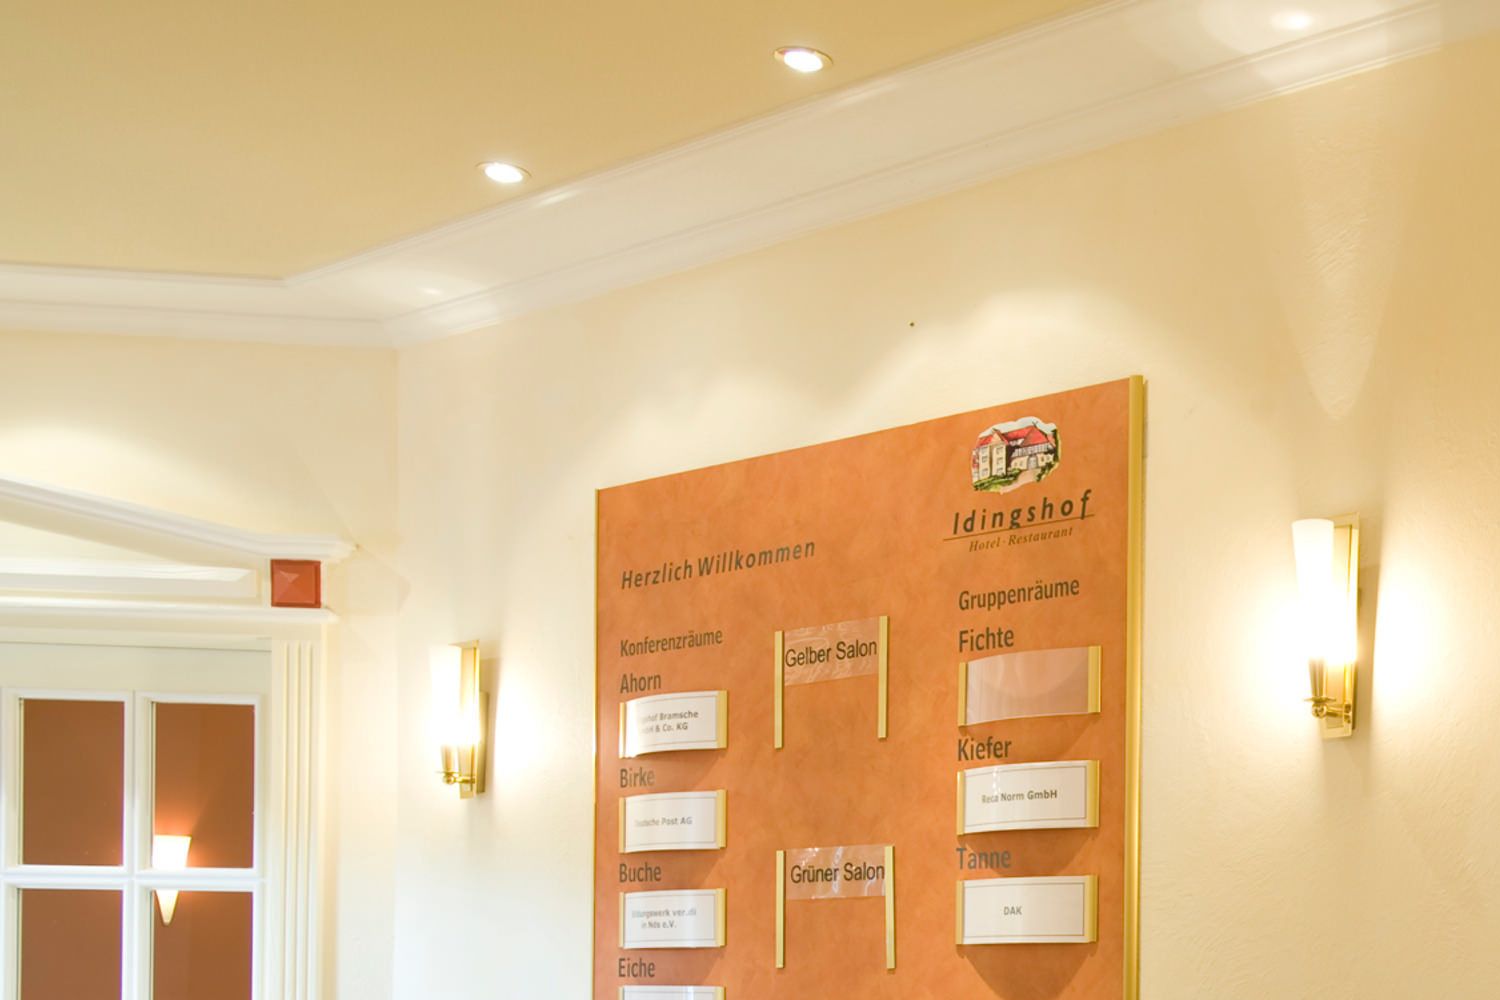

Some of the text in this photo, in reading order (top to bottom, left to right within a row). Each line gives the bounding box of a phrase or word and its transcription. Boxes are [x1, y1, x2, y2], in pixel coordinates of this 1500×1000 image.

[953, 489, 1092, 534] Idingshof
[969, 527, 1074, 552] Hotel Restaurant
[621, 541, 816, 590] Herzlich Willkommen
[959, 579, 1080, 611] Gruppenräume
[620, 630, 723, 657] Konferenzräume
[959, 627, 1014, 652] Fichte
[785, 639, 877, 667] Gelber Salon
[620, 672, 661, 694] Ahorn
[676, 721, 688, 731] KG
[957, 736, 1012, 762] Kiefer
[620, 766, 655, 788] Birke
[1000, 793, 1025, 802] Norm
[1027, 789, 1058, 800] GmbH
[661, 816, 678, 826] Post
[680, 816, 693, 825] AG
[956, 847, 1012, 870] Tanne
[619, 862, 661, 883] Buche
[791, 862, 885, 883] Grüner Salon
[1003, 906, 1023, 916] DAK
[619, 957, 656, 977] Eiche
